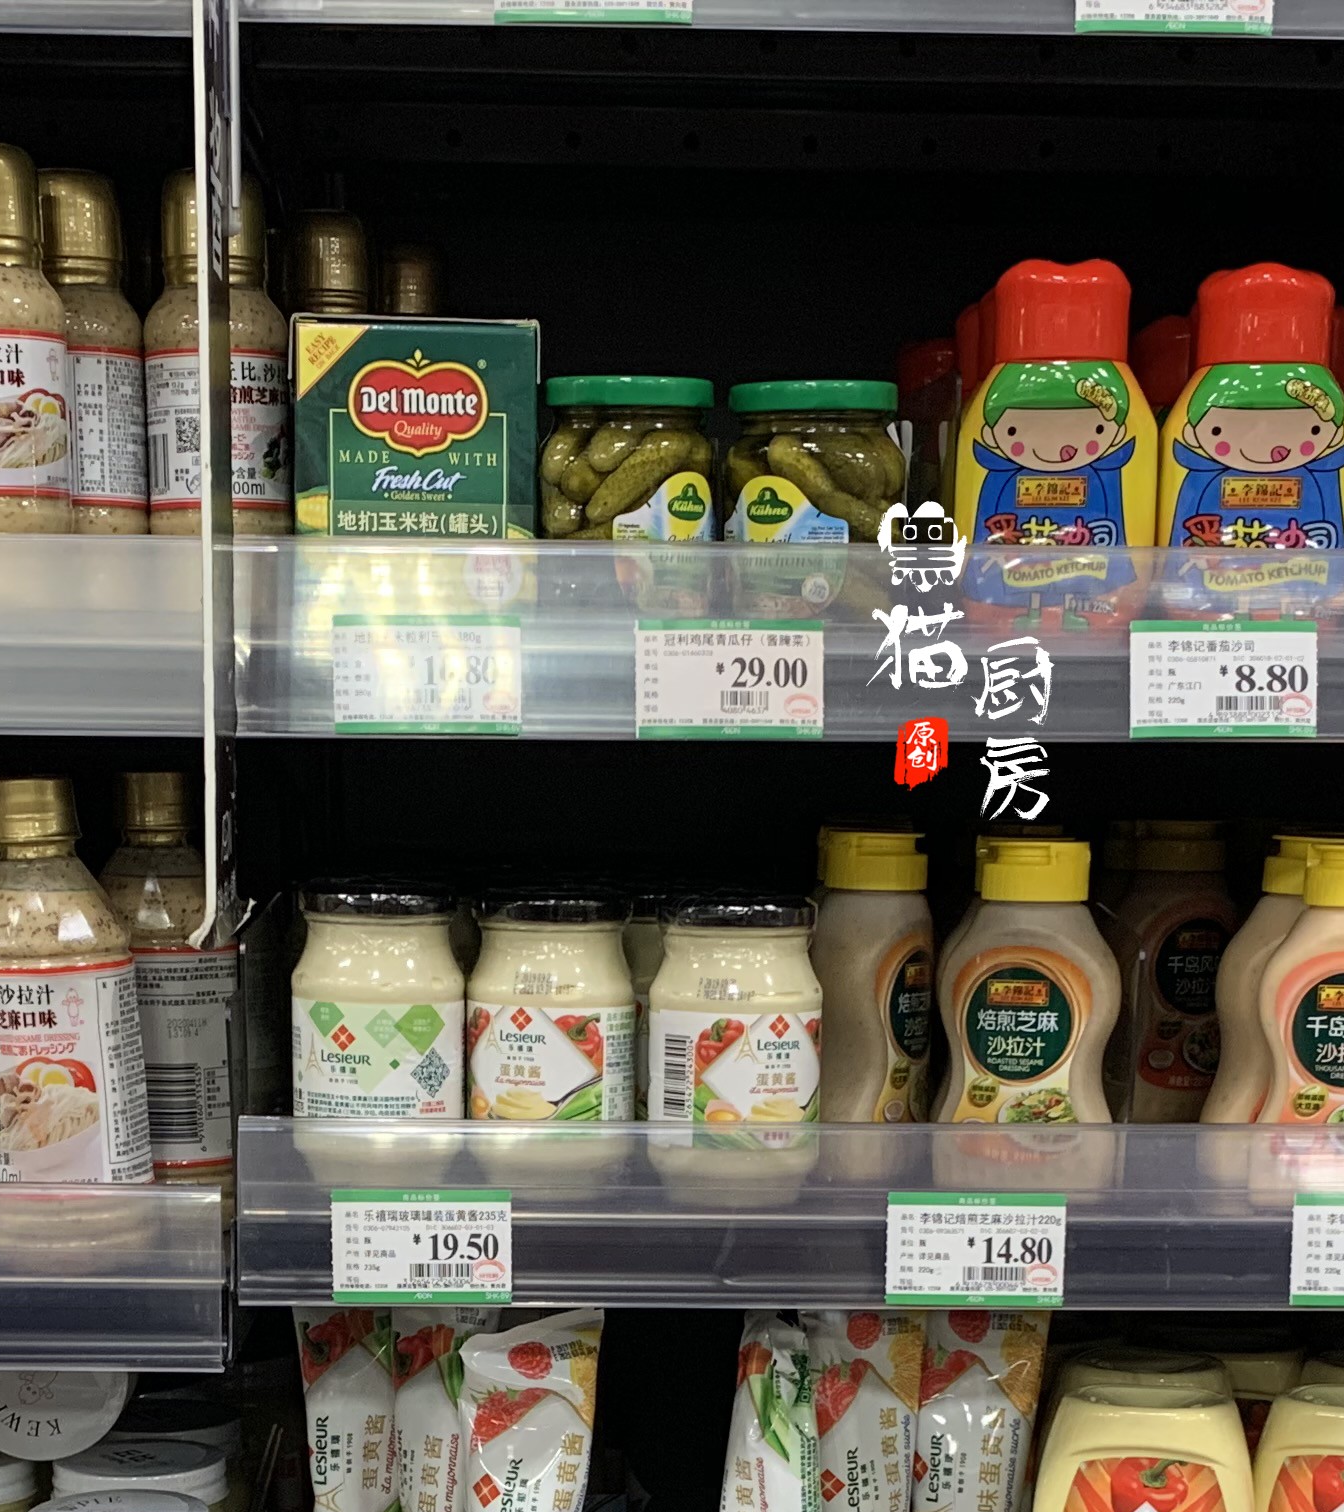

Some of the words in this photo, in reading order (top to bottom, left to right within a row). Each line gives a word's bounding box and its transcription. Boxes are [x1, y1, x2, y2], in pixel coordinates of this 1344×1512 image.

[360, 386, 398, 413] Del
[403, 387, 478, 416] Monte
[394, 420, 443, 440] Quality
[338, 450, 390, 464] MADE
[448, 453, 497, 467] WITH
[372, 466, 422, 492] Fresh
[423, 468, 467, 492] Cut
[1006, 567, 1054, 582] TOMATO
[1056, 560, 1107, 577] KETCHUP
[1168, 641, 1255, 653] 李锦记番茄沙司
[730, 657, 808, 688] 29.00
[1234, 664, 1309, 694] 8.80
[976, 1010, 1059, 1033] 焙煎芝麻
[986, 1036, 1045, 1056] 沙拉汁
[499, 1063, 541, 1079] 蛋黄酱
[429, 1233, 499, 1262] 19.50
[982, 1237, 1053, 1265] 14.80
